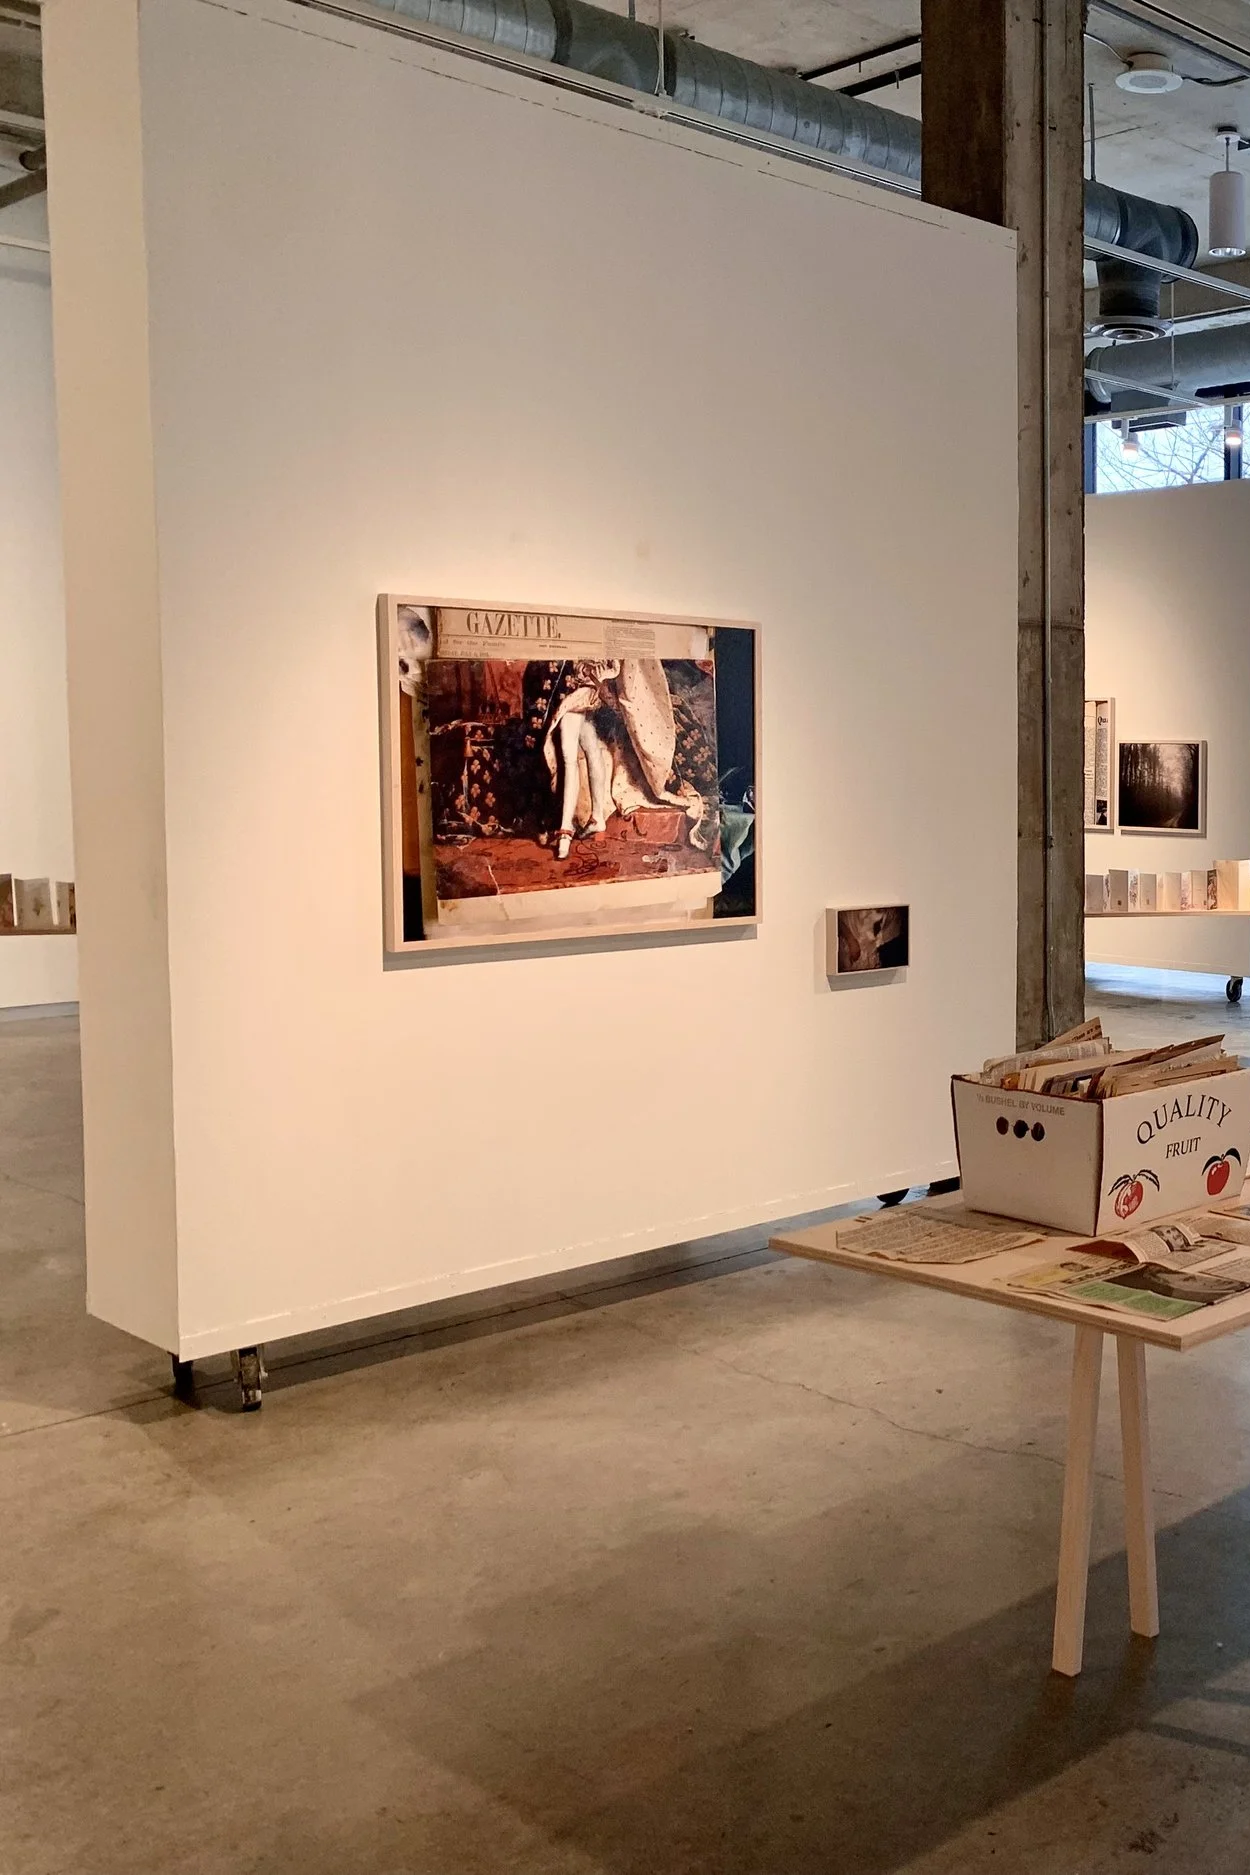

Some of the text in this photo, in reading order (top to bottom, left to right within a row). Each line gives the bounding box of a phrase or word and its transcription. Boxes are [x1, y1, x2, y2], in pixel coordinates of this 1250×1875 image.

[985, 1094, 1018, 1108] BUSHEL
[1019, 1100, 1030, 1110] BY
[1031, 1102, 1066, 1116] VOLUME
[1136, 1094, 1232, 1145] QUALITY
[1165, 1136, 1202, 1159] FRUIT
